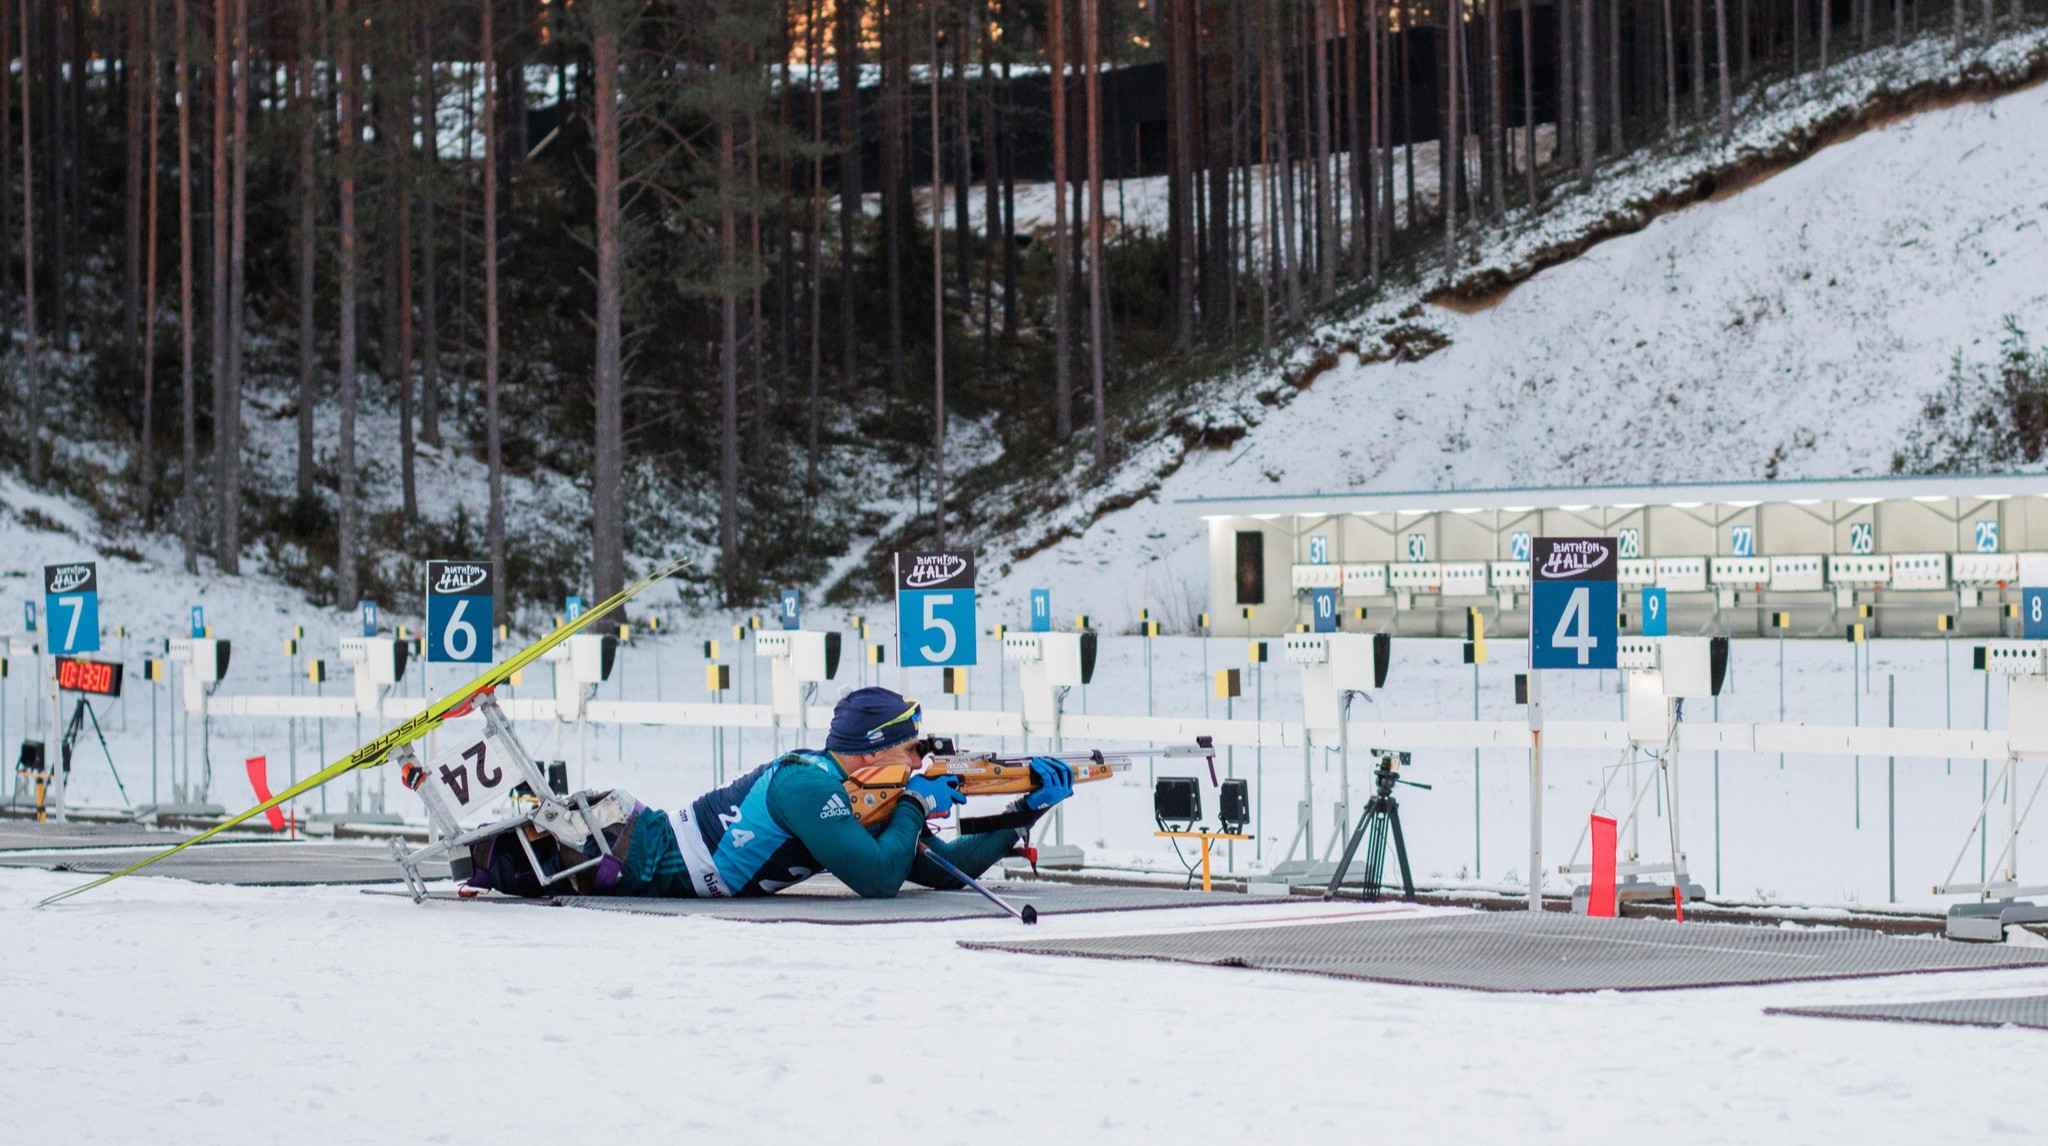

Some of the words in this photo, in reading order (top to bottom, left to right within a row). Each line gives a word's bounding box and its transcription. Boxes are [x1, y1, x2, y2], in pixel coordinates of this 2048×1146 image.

[1311, 536, 1327, 563] 31
[1409, 534, 1426, 562] 30
[1512, 533, 1530, 561] 29
[1620, 530, 1639, 558] 28
[1732, 527, 1752, 556] 27
[1851, 524, 1872, 554] 26
[1977, 522, 1998, 553] 25
[912, 565, 953, 582] 4ALL
[1547, 552, 1593, 573] 4ALL
[440, 574, 474, 589] 4ALL
[784, 596, 796, 617] 12
[1034, 595, 1045, 617] 11
[1317, 595, 1331, 618] 10
[1648, 595, 1659, 620] 9
[2031, 595, 2043, 623] 8
[58, 595, 84, 651] 7
[443, 599, 477, 661] 6
[920, 594, 957, 663] 5
[1551, 587, 1598, 665] 4
[59, 660, 112, 693] 10:13:30
[350, 710, 430, 764] FISCHER
[438, 740, 503, 806] 24
[717, 804, 756, 848] 24
[819, 807, 852, 820] adidas
